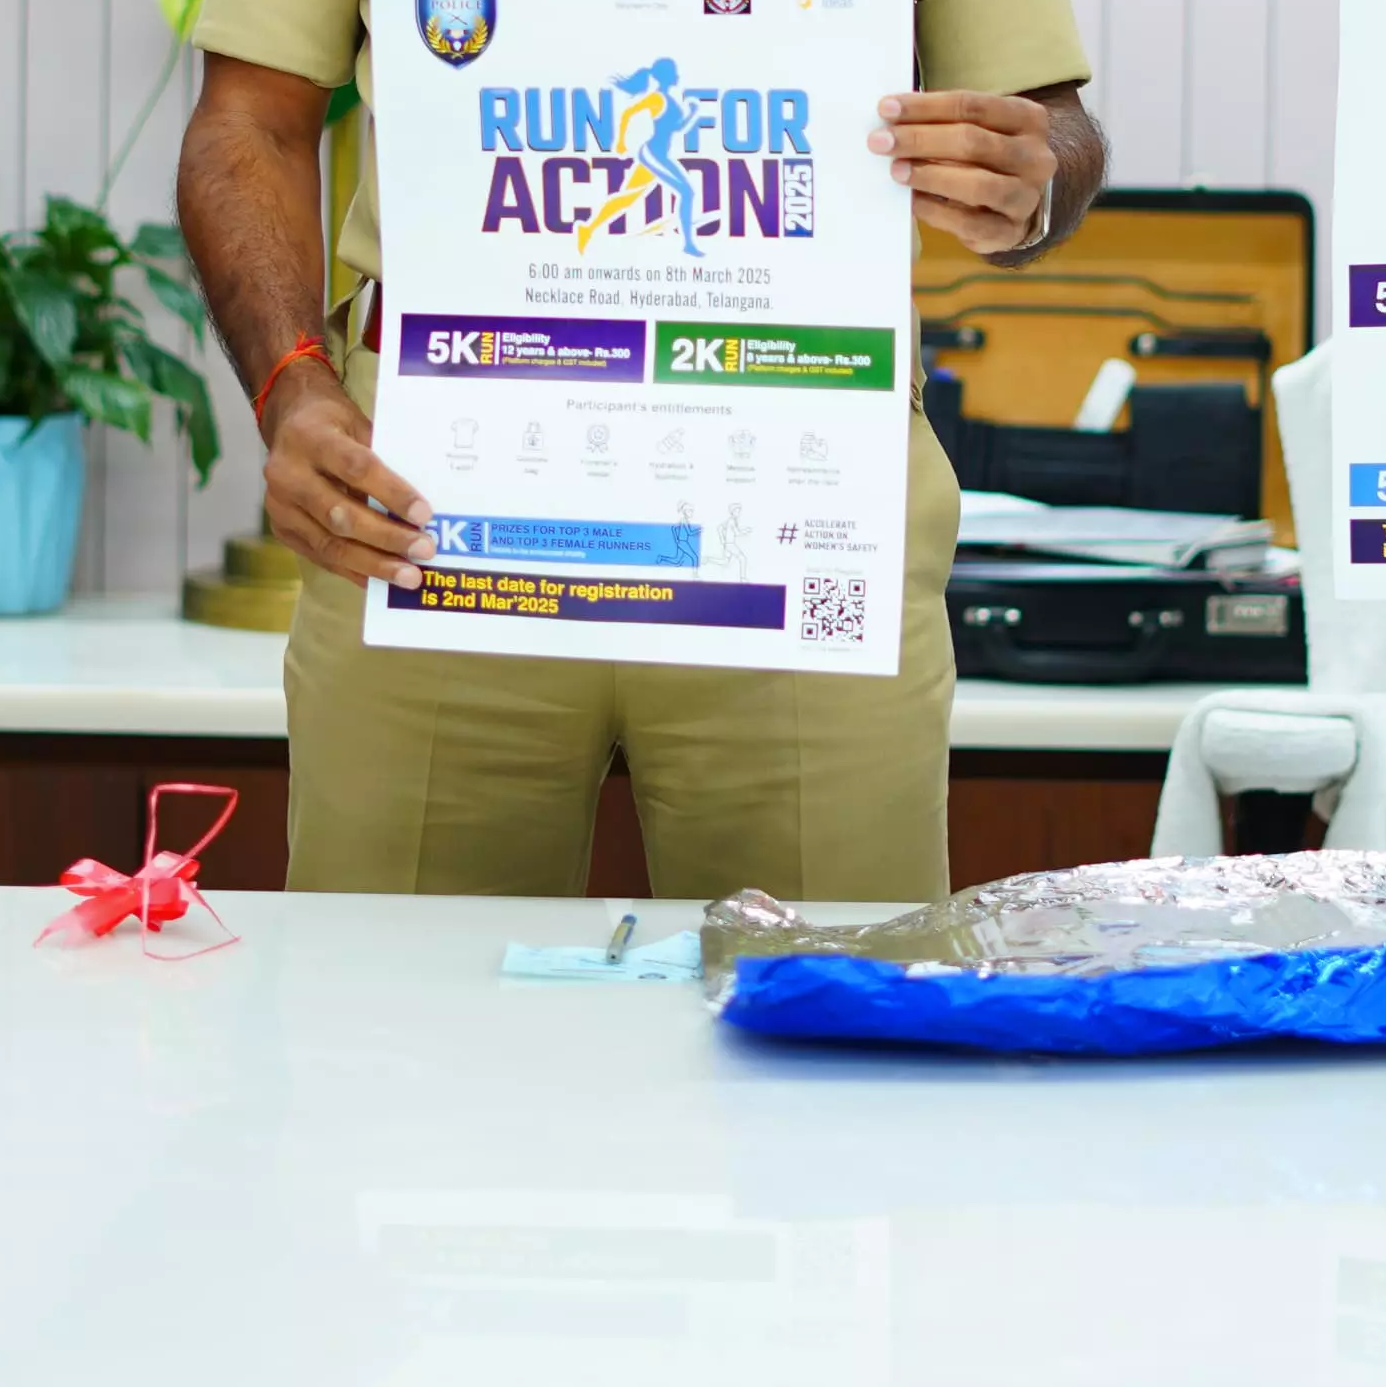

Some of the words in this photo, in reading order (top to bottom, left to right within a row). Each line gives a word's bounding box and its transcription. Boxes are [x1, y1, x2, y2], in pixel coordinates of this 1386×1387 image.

[479, 87, 614, 153] RUN
[682, 88, 812, 154] FOR
[784, 163, 814, 233] 2025
[564, 269, 583, 281] am
[588, 265, 641, 281] onwards
[647, 269, 661, 282] on
[666, 265, 687, 283] 8th
[693, 266, 731, 284] March
[738, 267, 770, 284] 2025
[427, 332, 480, 363] 5K
[481, 333, 493, 363] RUN
[503, 334, 550, 344] Eligibility
[747, 341, 795, 352] Eligibility
[671, 339, 724, 371] 2K
[726, 340, 738, 371] RUN
[423, 590, 437, 605] is
[443, 592, 475, 607] 2nd
[482, 595, 559, 613] Mar'2025
[424, 571, 456, 588] The
[461, 574, 493, 590] last
[497, 577, 535, 593] date
[540, 580, 564, 596] for
[569, 583, 672, 602] registration
